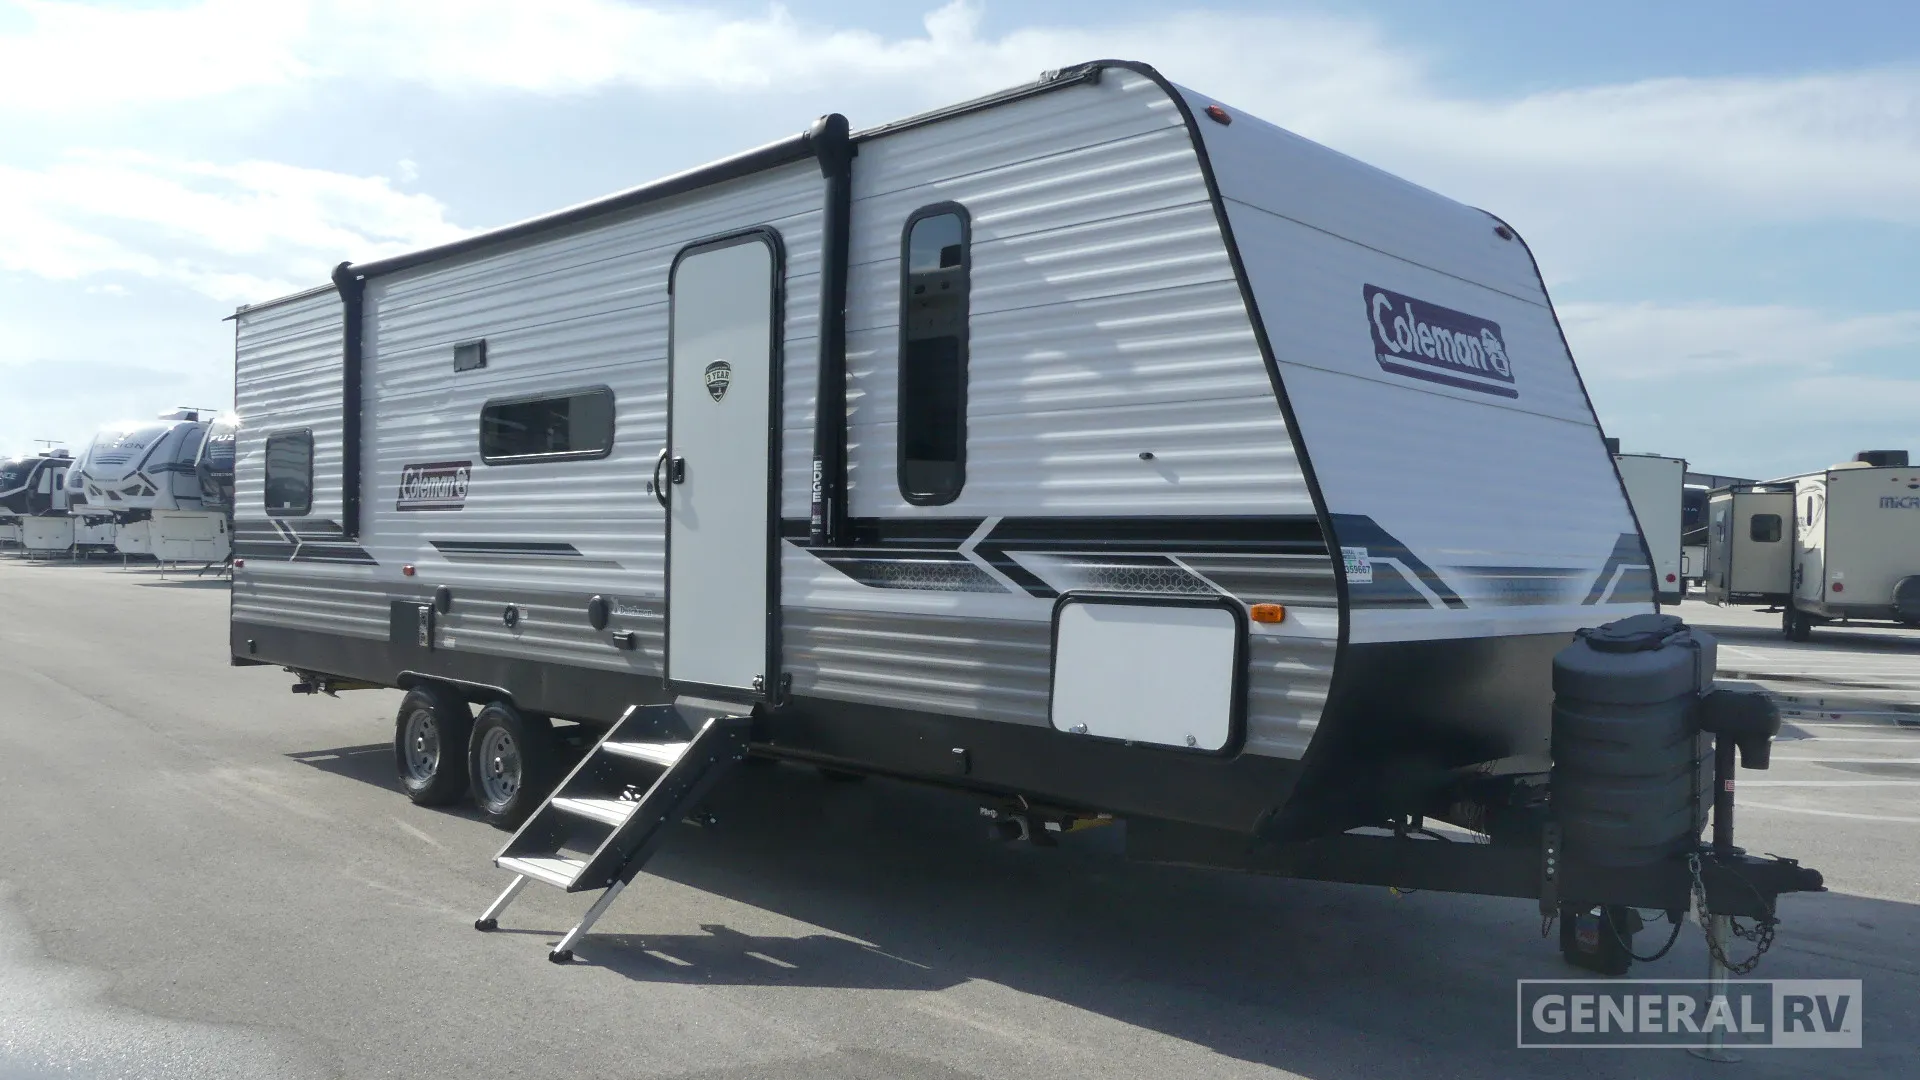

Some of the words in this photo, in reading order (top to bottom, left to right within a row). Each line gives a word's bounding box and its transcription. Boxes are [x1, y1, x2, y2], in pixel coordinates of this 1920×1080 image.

[1372, 292, 1489, 371] Coleman
[712, 370, 730, 380] YEAR
[402, 467, 456, 500] Coleman
[812, 460, 823, 503] EDGE
